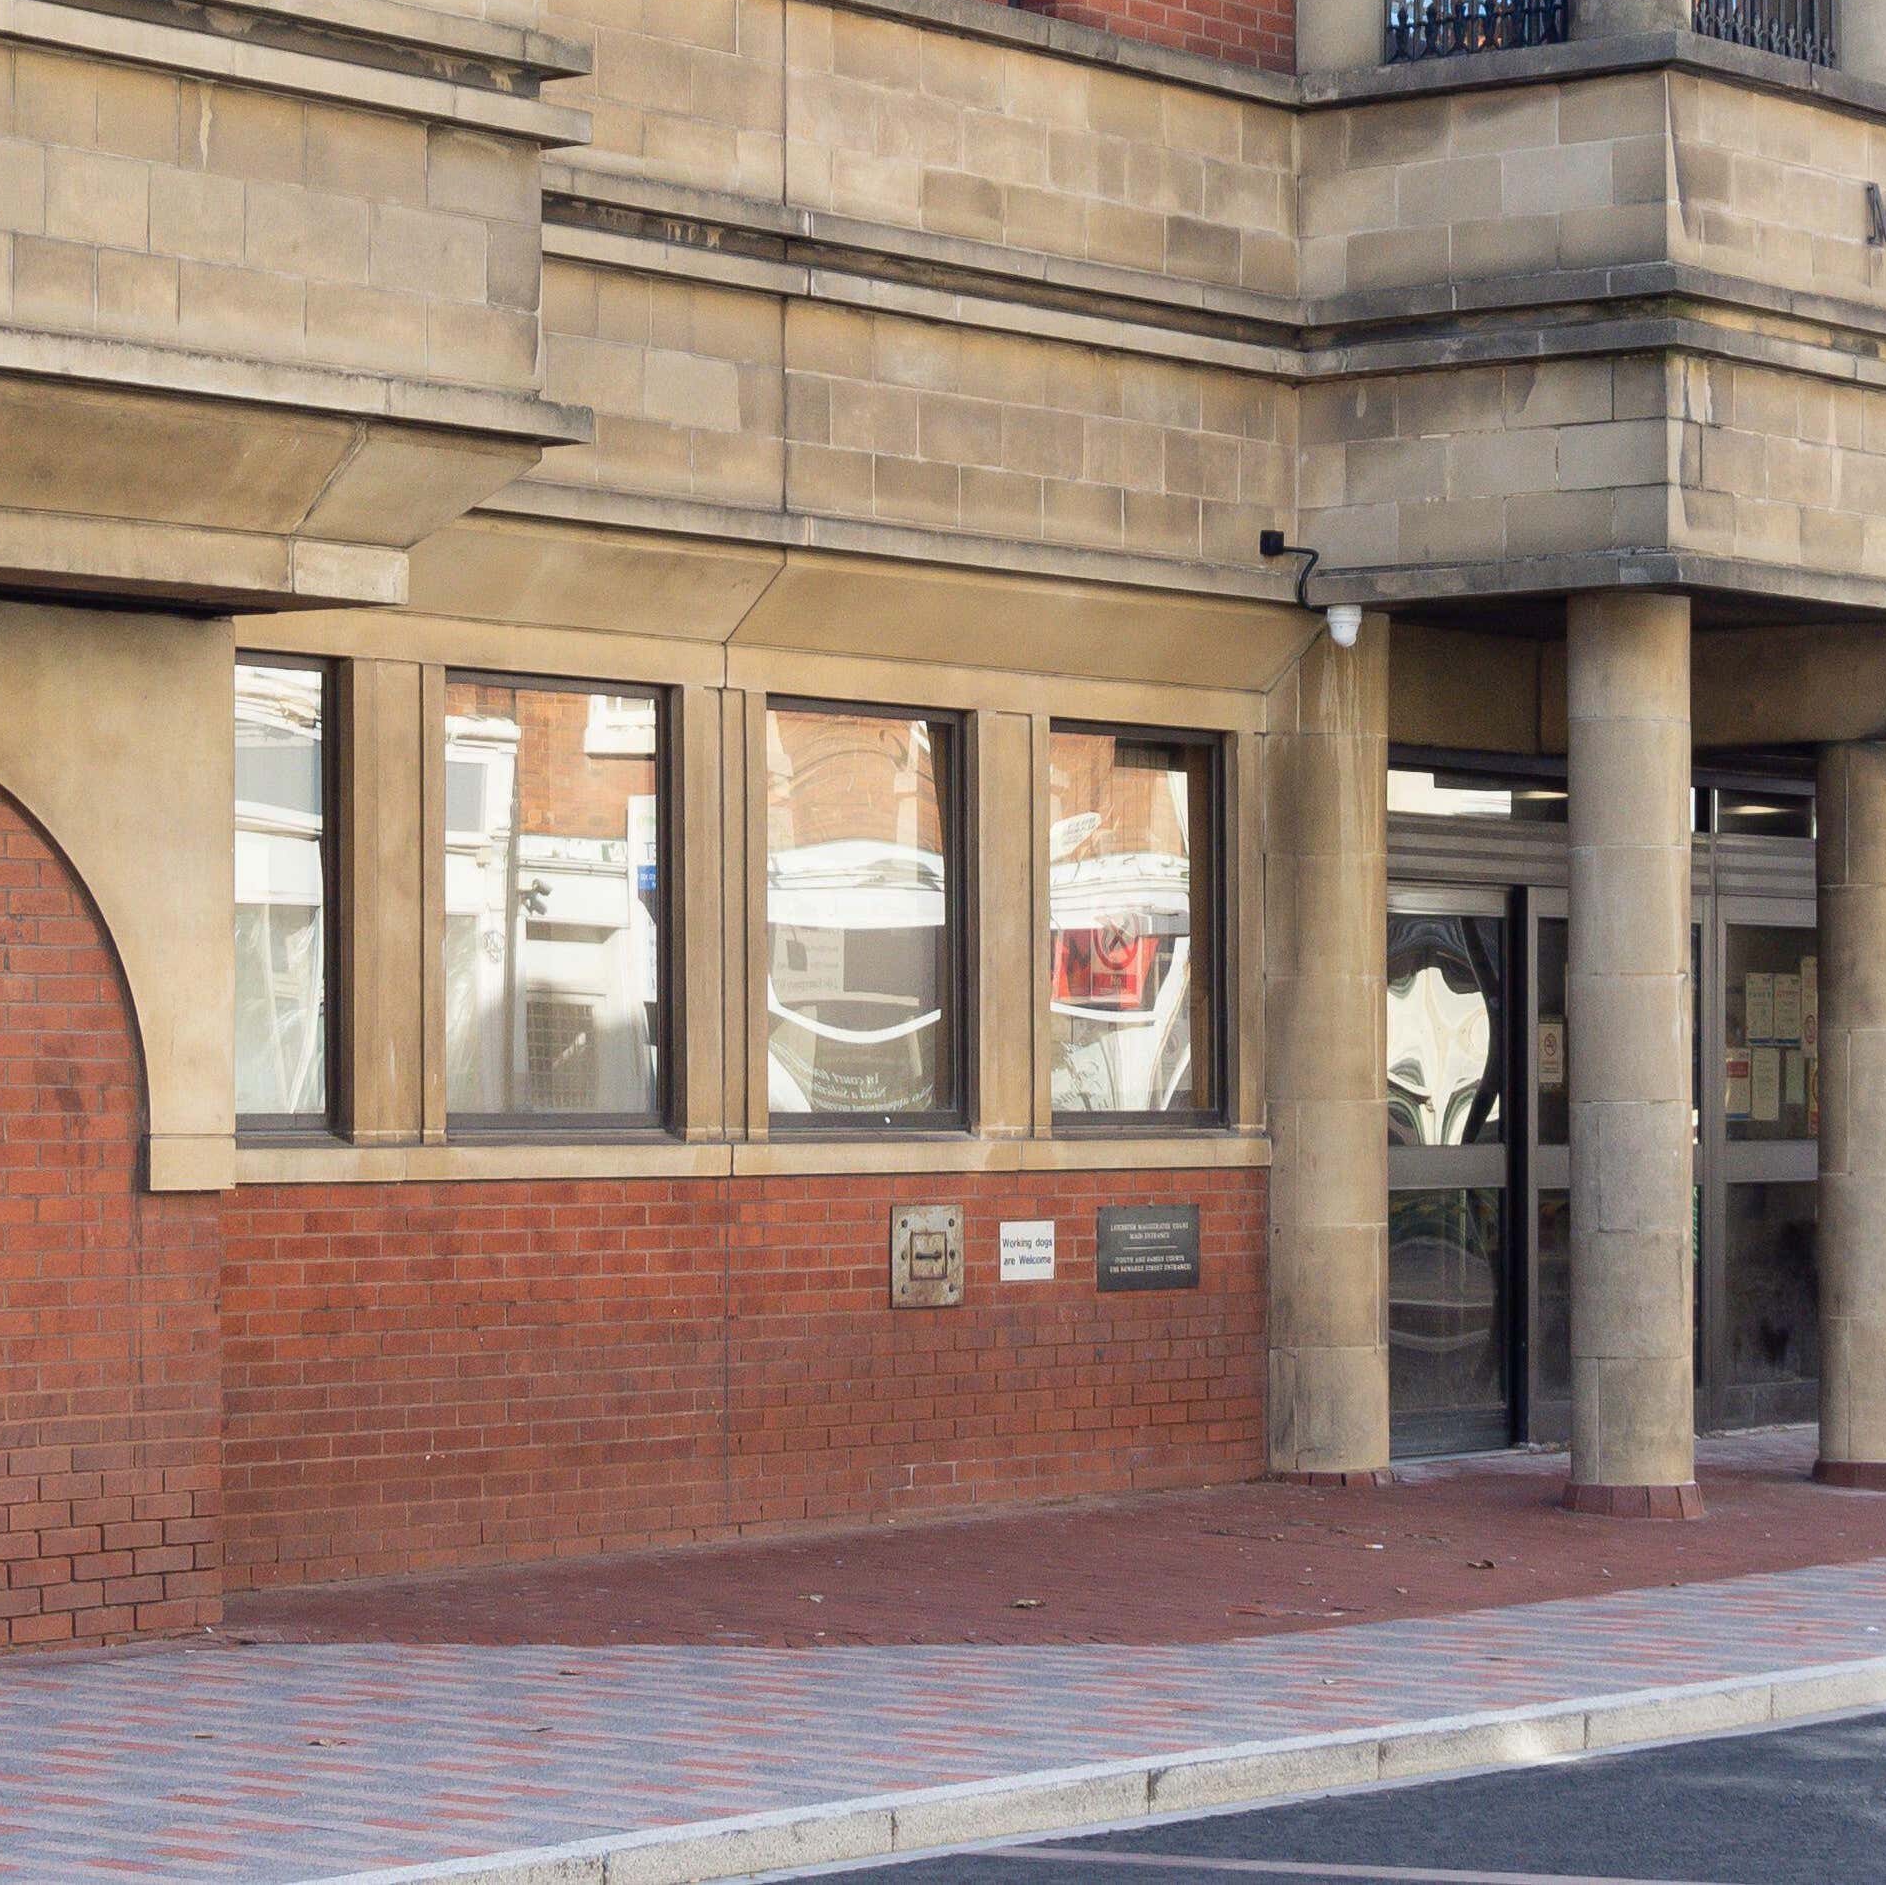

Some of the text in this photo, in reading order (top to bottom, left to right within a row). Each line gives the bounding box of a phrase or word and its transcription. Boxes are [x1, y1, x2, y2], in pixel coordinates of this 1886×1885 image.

[1002, 1236, 1052, 1249] Working dogs
[1018, 1254, 1051, 1265] Welcome
